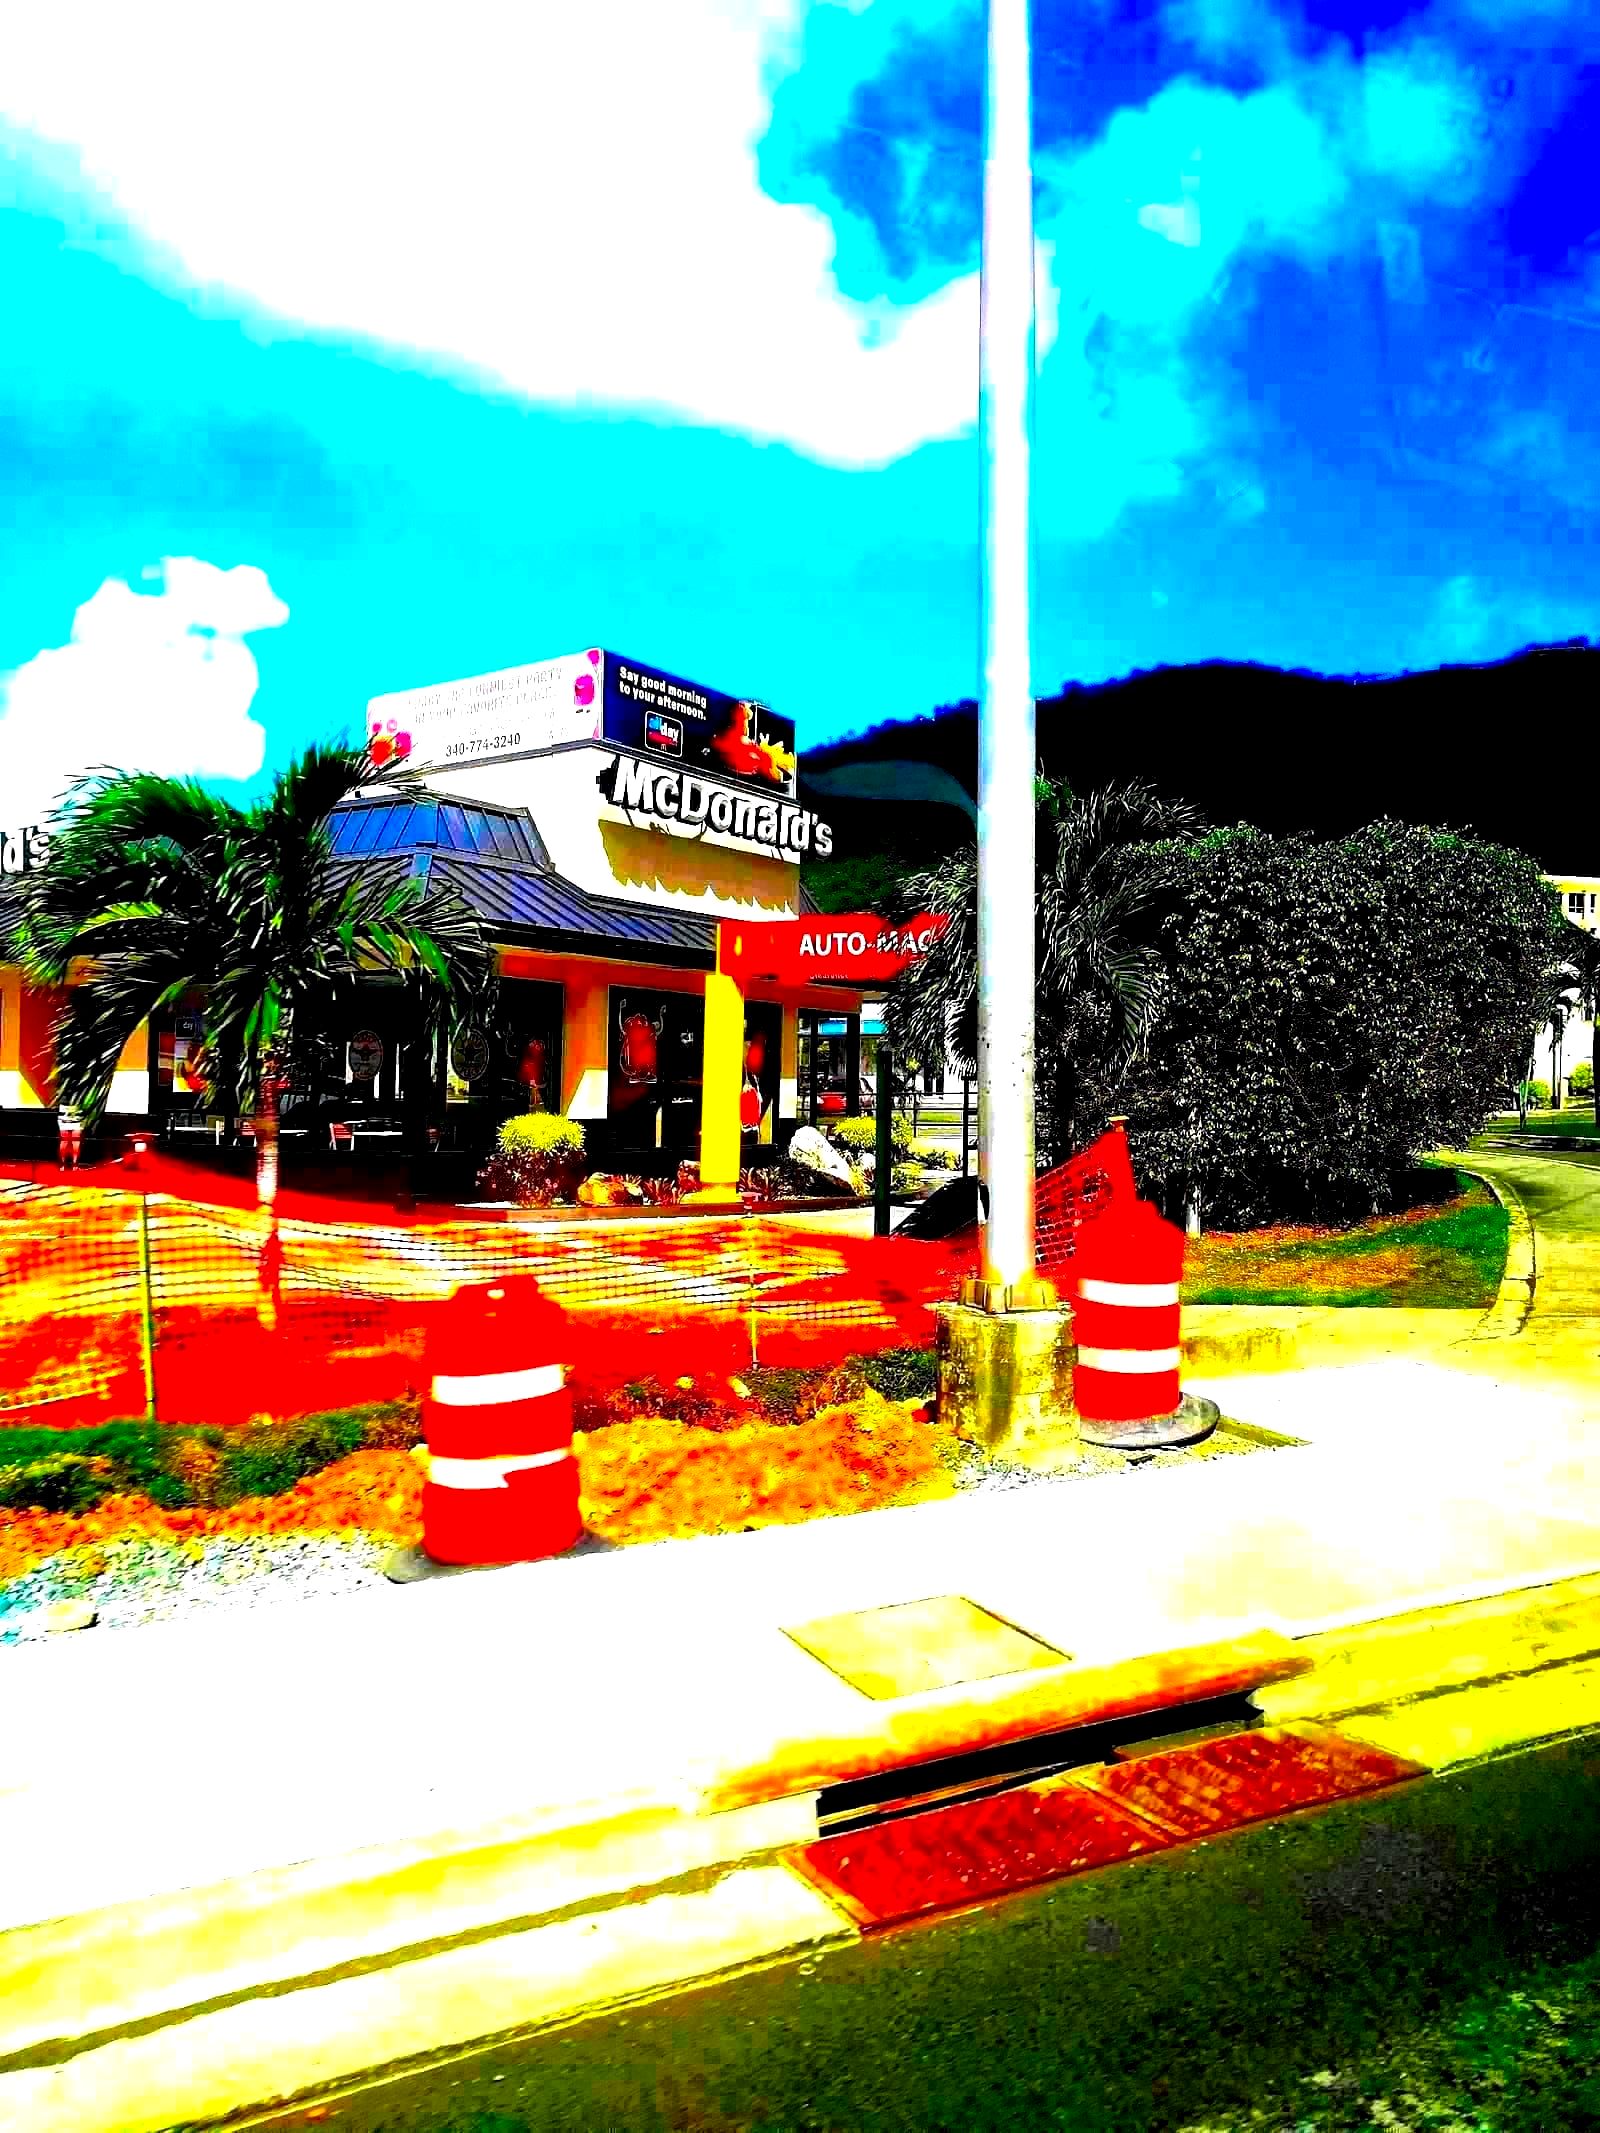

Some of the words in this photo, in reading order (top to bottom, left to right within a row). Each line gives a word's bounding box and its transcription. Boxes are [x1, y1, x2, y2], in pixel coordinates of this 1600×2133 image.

[619, 666, 639, 685] Say
[641, 676, 666, 693] good
[668, 685, 707, 709] morning
[619, 681, 630, 695] to
[633, 687, 655, 703] your
[657, 695, 707, 720] afternoon.
[445, 732, 521, 757] 340-774-3240
[612, 755, 833, 858] McDonald's
[0, 827, 50, 873] d's
